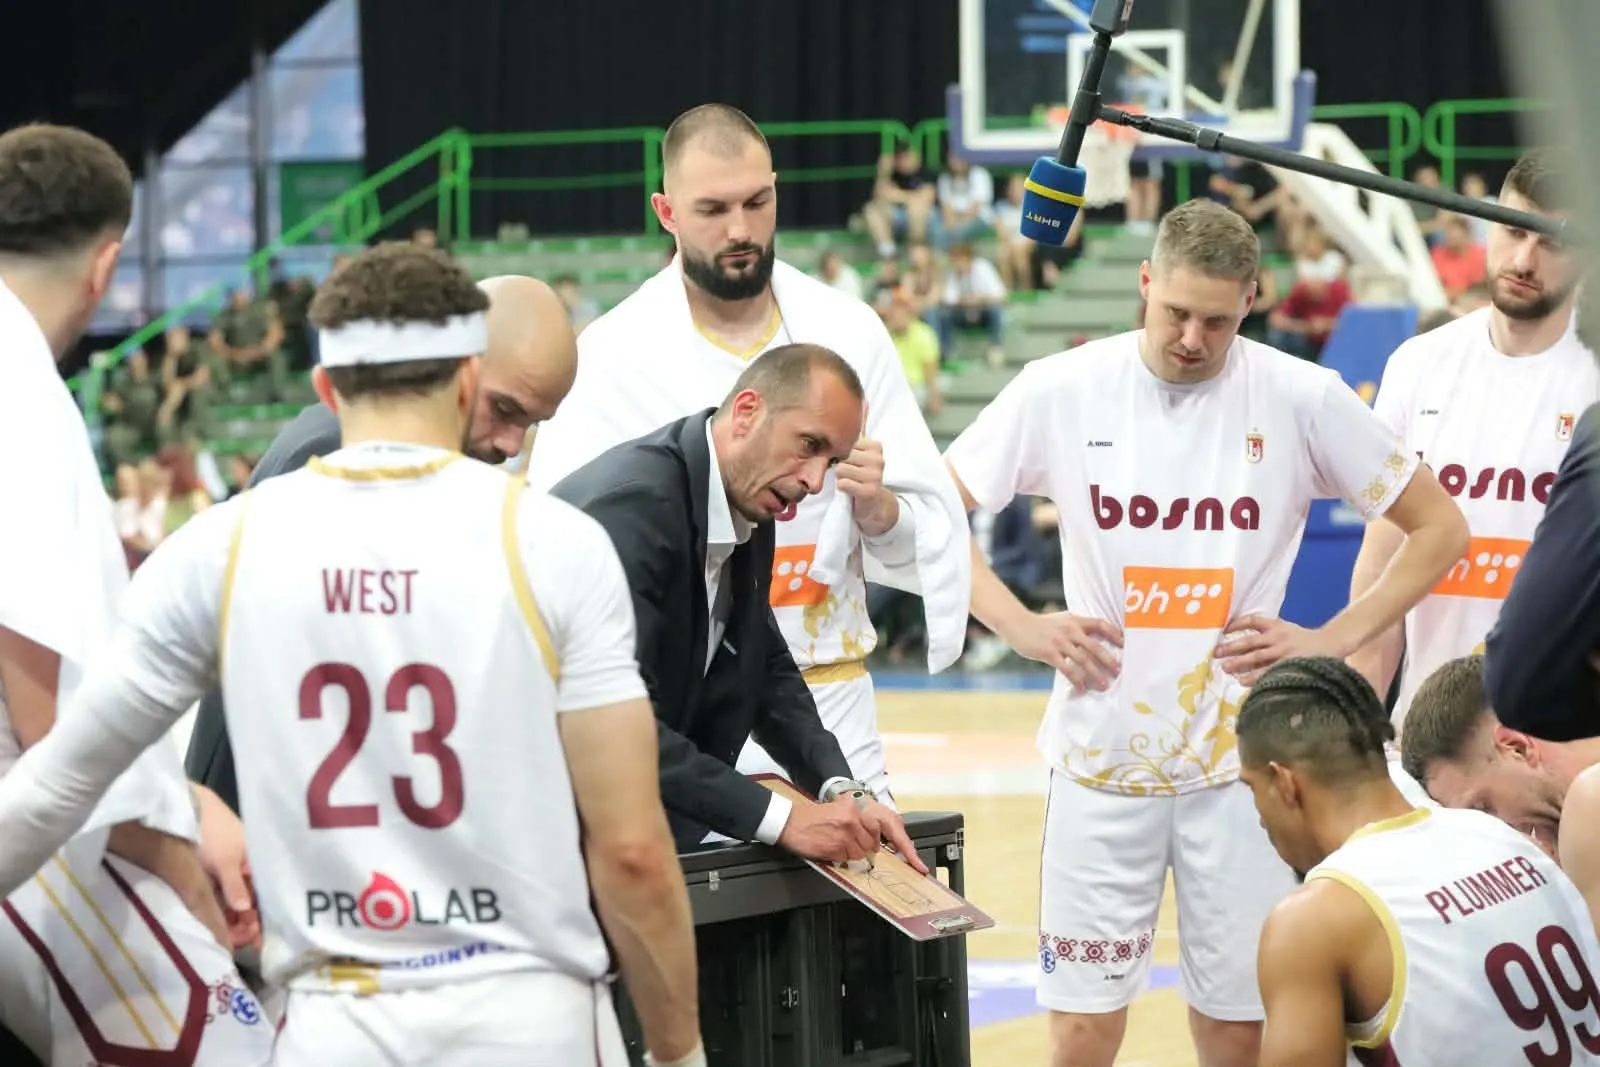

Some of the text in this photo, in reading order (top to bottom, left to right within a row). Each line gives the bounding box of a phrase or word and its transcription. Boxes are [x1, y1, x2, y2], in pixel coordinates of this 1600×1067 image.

[1089, 484, 1261, 530] bosna
[322, 568, 419, 614] WEST
[1124, 582, 1169, 614] bh
[298, 662, 464, 829] 23
[306, 871, 502, 931] PROLAB
[1424, 856, 1548, 924] PLUMMER
[1485, 925, 1600, 1067] 99
